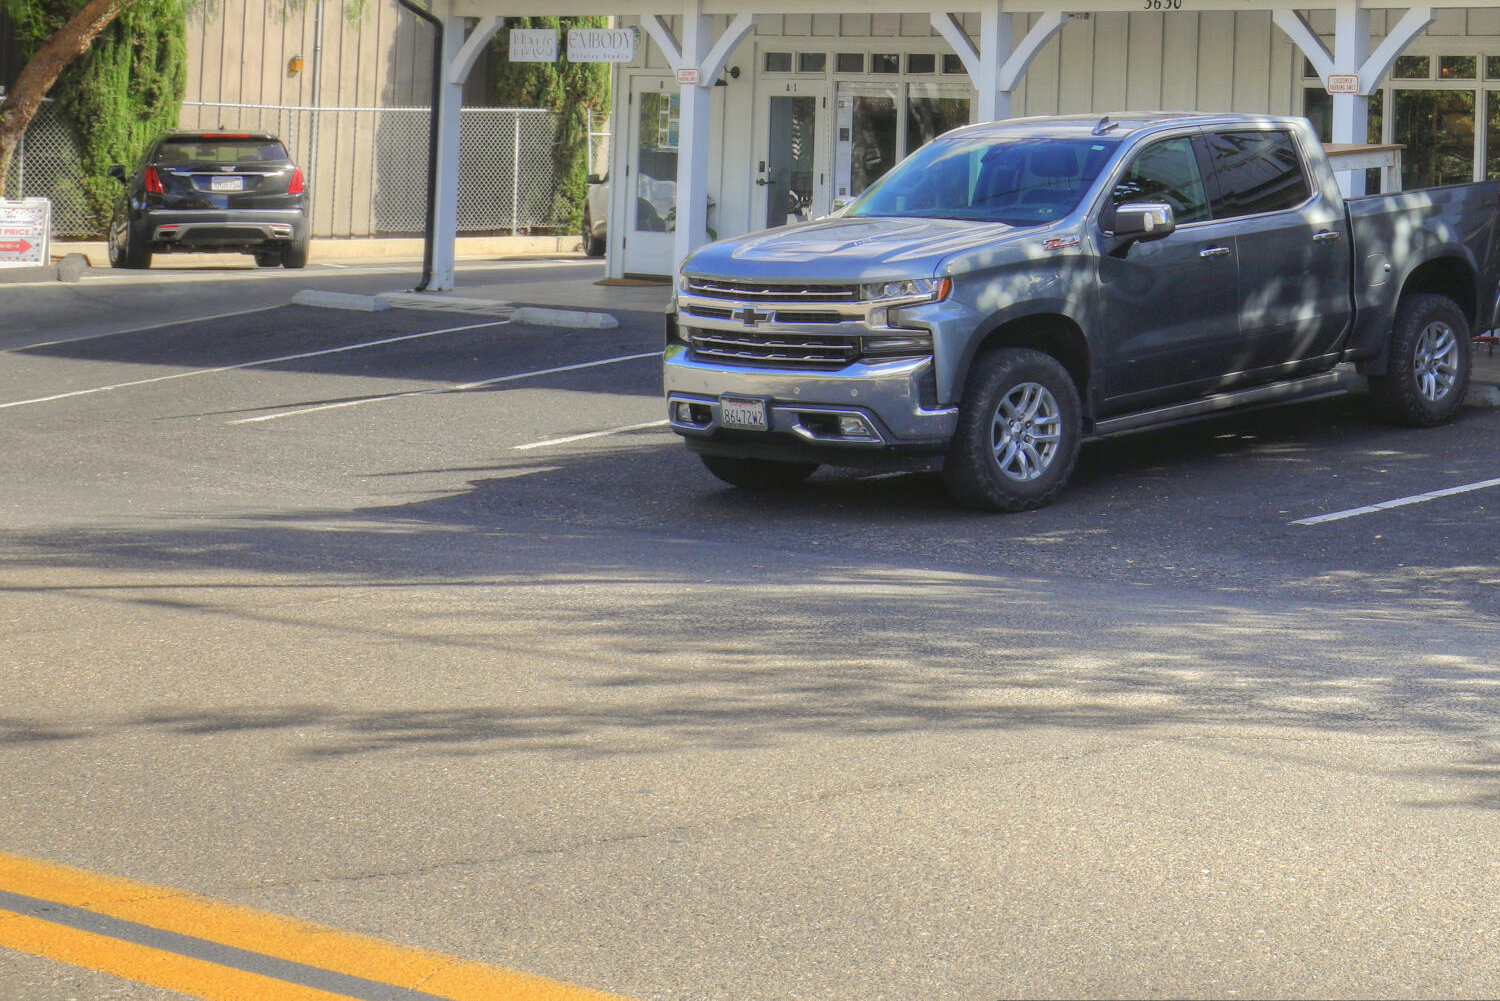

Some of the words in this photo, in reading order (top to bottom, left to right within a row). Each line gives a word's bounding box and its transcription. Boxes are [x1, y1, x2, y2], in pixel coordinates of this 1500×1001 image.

[568, 31, 631, 49] EMBODY
[3, 228, 30, 236] PRICE
[724, 408, 764, 425] 86472W2
